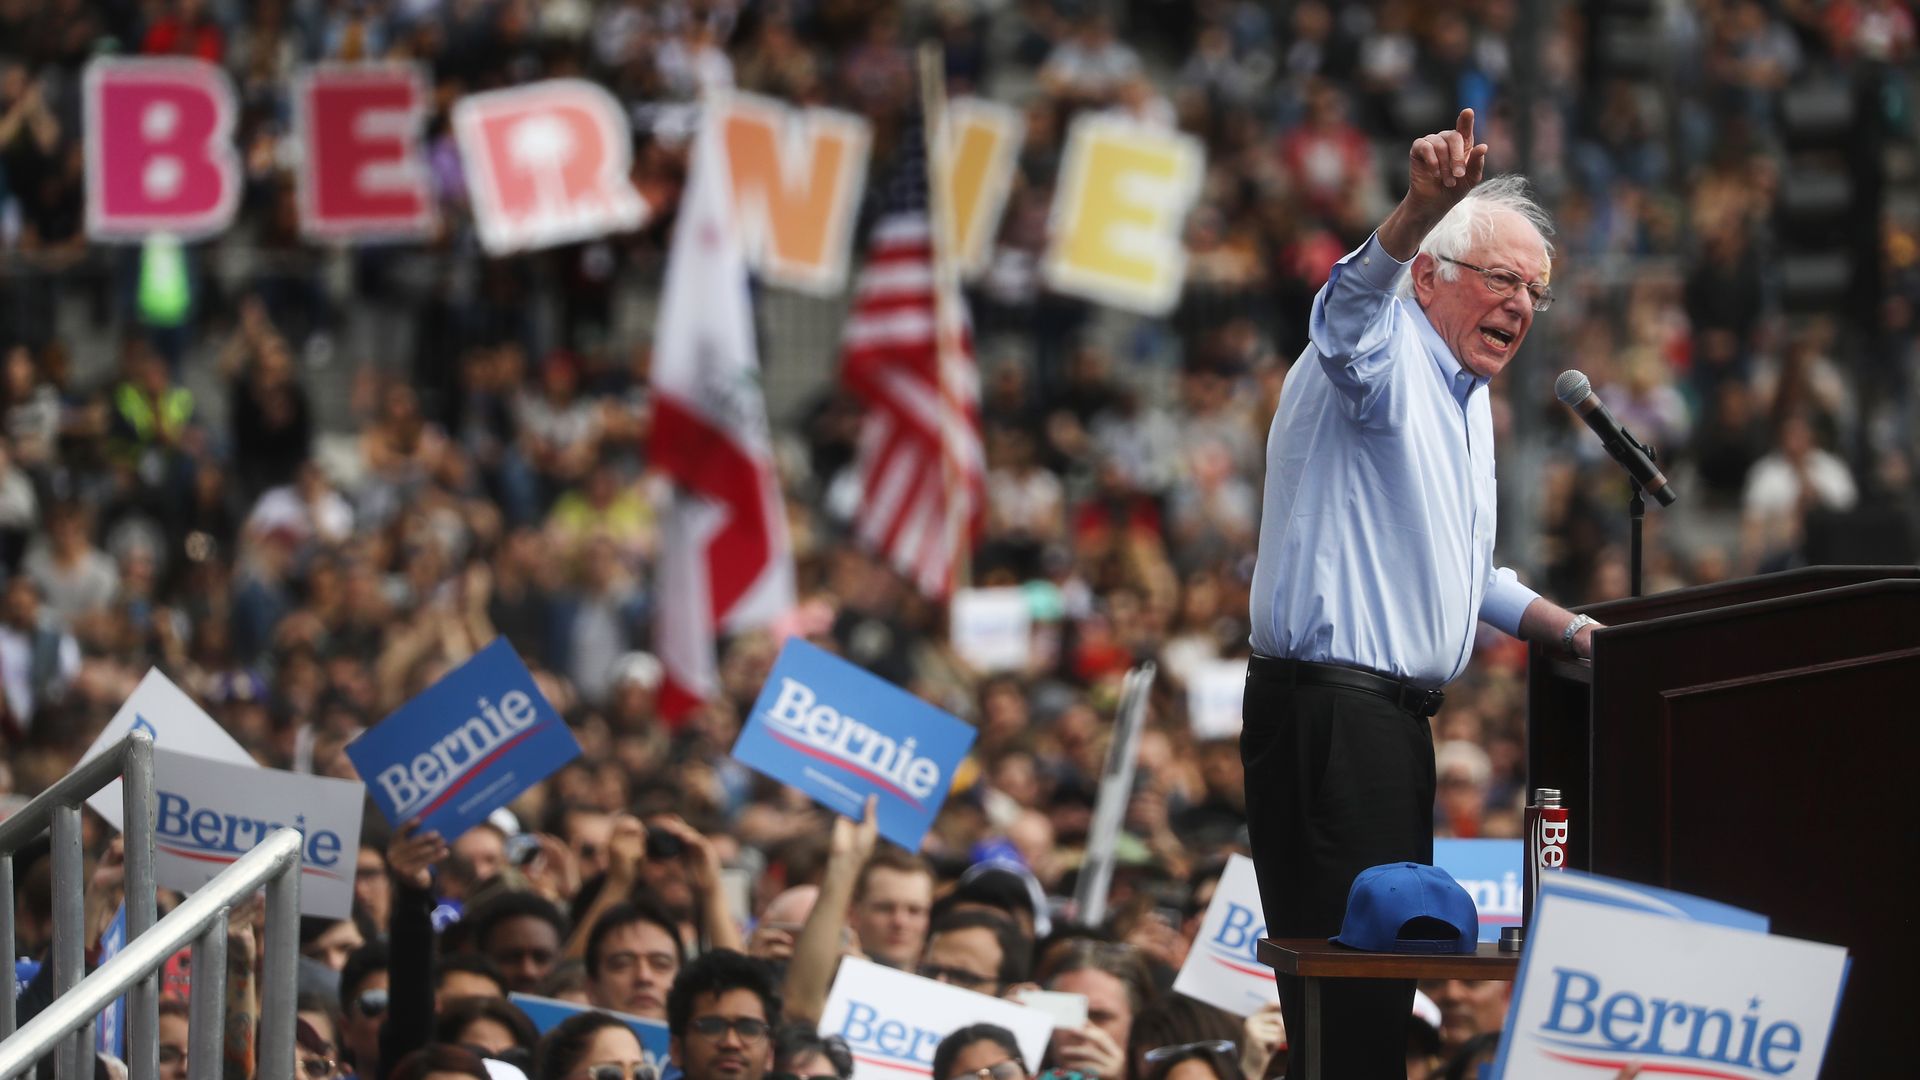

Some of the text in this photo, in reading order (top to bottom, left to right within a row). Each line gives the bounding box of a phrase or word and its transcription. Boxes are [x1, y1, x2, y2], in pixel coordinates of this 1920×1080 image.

[377, 690, 537, 817] Bernie
[767, 676, 941, 800] Bernie
[840, 999, 943, 1064] Ber
[1539, 966, 1802, 1077] Bernie
